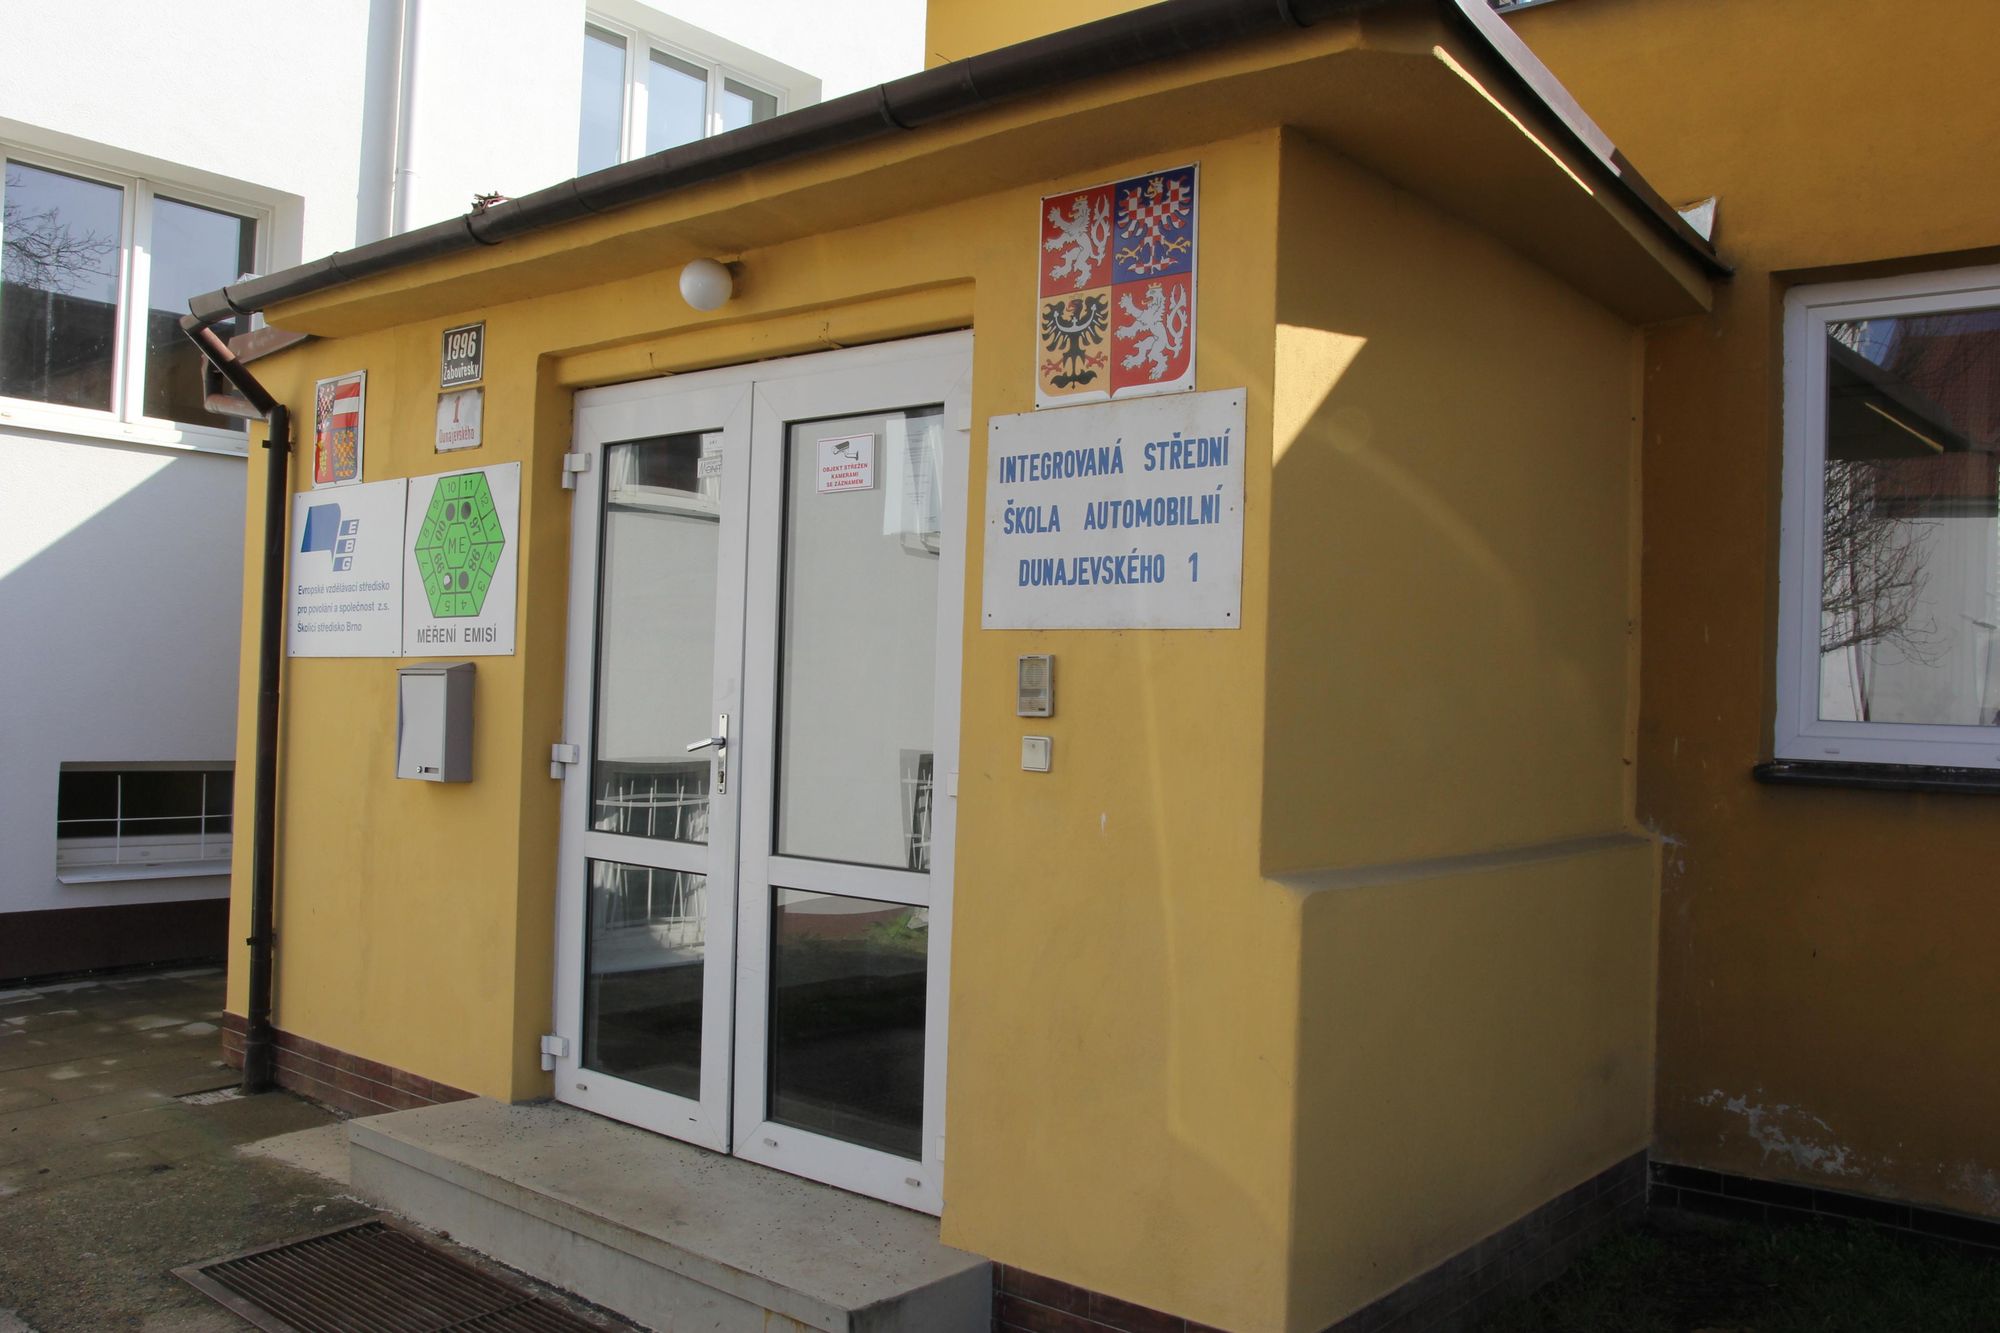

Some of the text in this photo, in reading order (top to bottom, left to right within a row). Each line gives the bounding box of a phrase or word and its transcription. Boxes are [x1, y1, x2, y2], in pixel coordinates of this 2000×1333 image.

[447, 331, 477, 361] 1996
[443, 361, 479, 381] Žabovřesky
[453, 395, 461, 423] 1
[999, 428, 1231, 484] INTEGROVANÁ STŘEDNÍ
[447, 480, 456, 493] 10
[463, 479, 473, 491] 11
[835, 479, 864, 487] ZÁZNAMEM
[1003, 484, 1223, 535] ŠKOLA AUTOMOBILNÍ
[1018, 548, 1199, 587] DUNAJEVSKÉHO 1
[359, 580, 390, 592] středisko
[297, 605, 307, 615] pro
[308, 603, 333, 615] povolání
[339, 601, 375, 614] společnost
[317, 621, 345, 632] středisko
[346, 621, 362, 632] Brno
[417, 623, 497, 643] MĚŘENÍ EMISÍ
